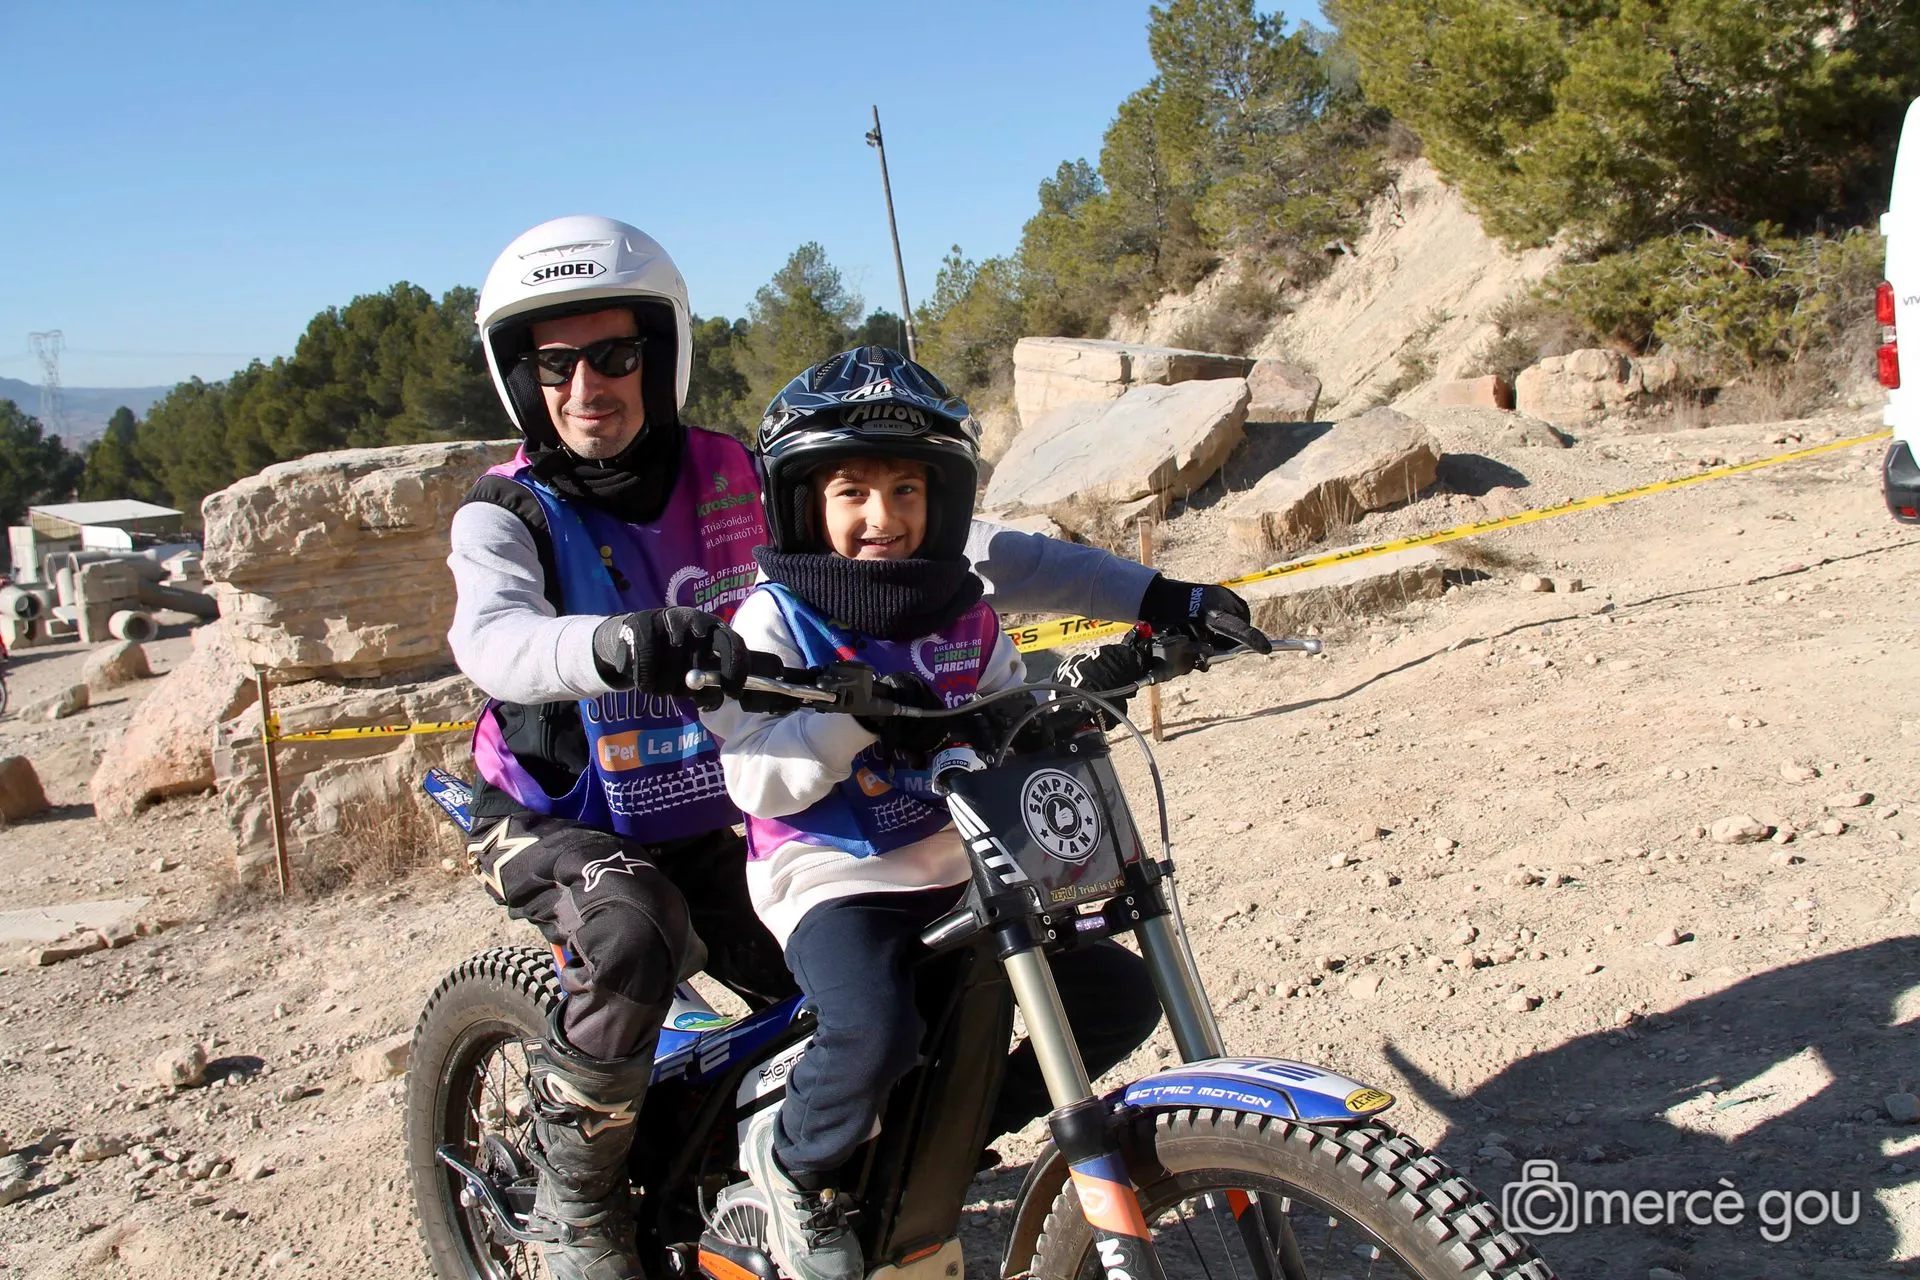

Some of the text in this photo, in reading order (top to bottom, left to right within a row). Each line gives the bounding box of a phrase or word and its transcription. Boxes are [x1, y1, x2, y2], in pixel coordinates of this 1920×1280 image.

[532, 263, 594, 282] SHOEI
[693, 561, 758, 591] AREA OFF-ROAD
[694, 571, 758, 604] CIRCUIT
[934, 642, 954, 653] AREA
[604, 743, 635, 762] Per
[647, 738, 673, 755] La
[1029, 778, 1086, 814] SEMPRE
[1058, 831, 1092, 854] IAN
[1079, 884, 1098, 895] Trial
[1100, 882, 1108, 891] is
[1197, 1086, 1272, 1109] MOTION
